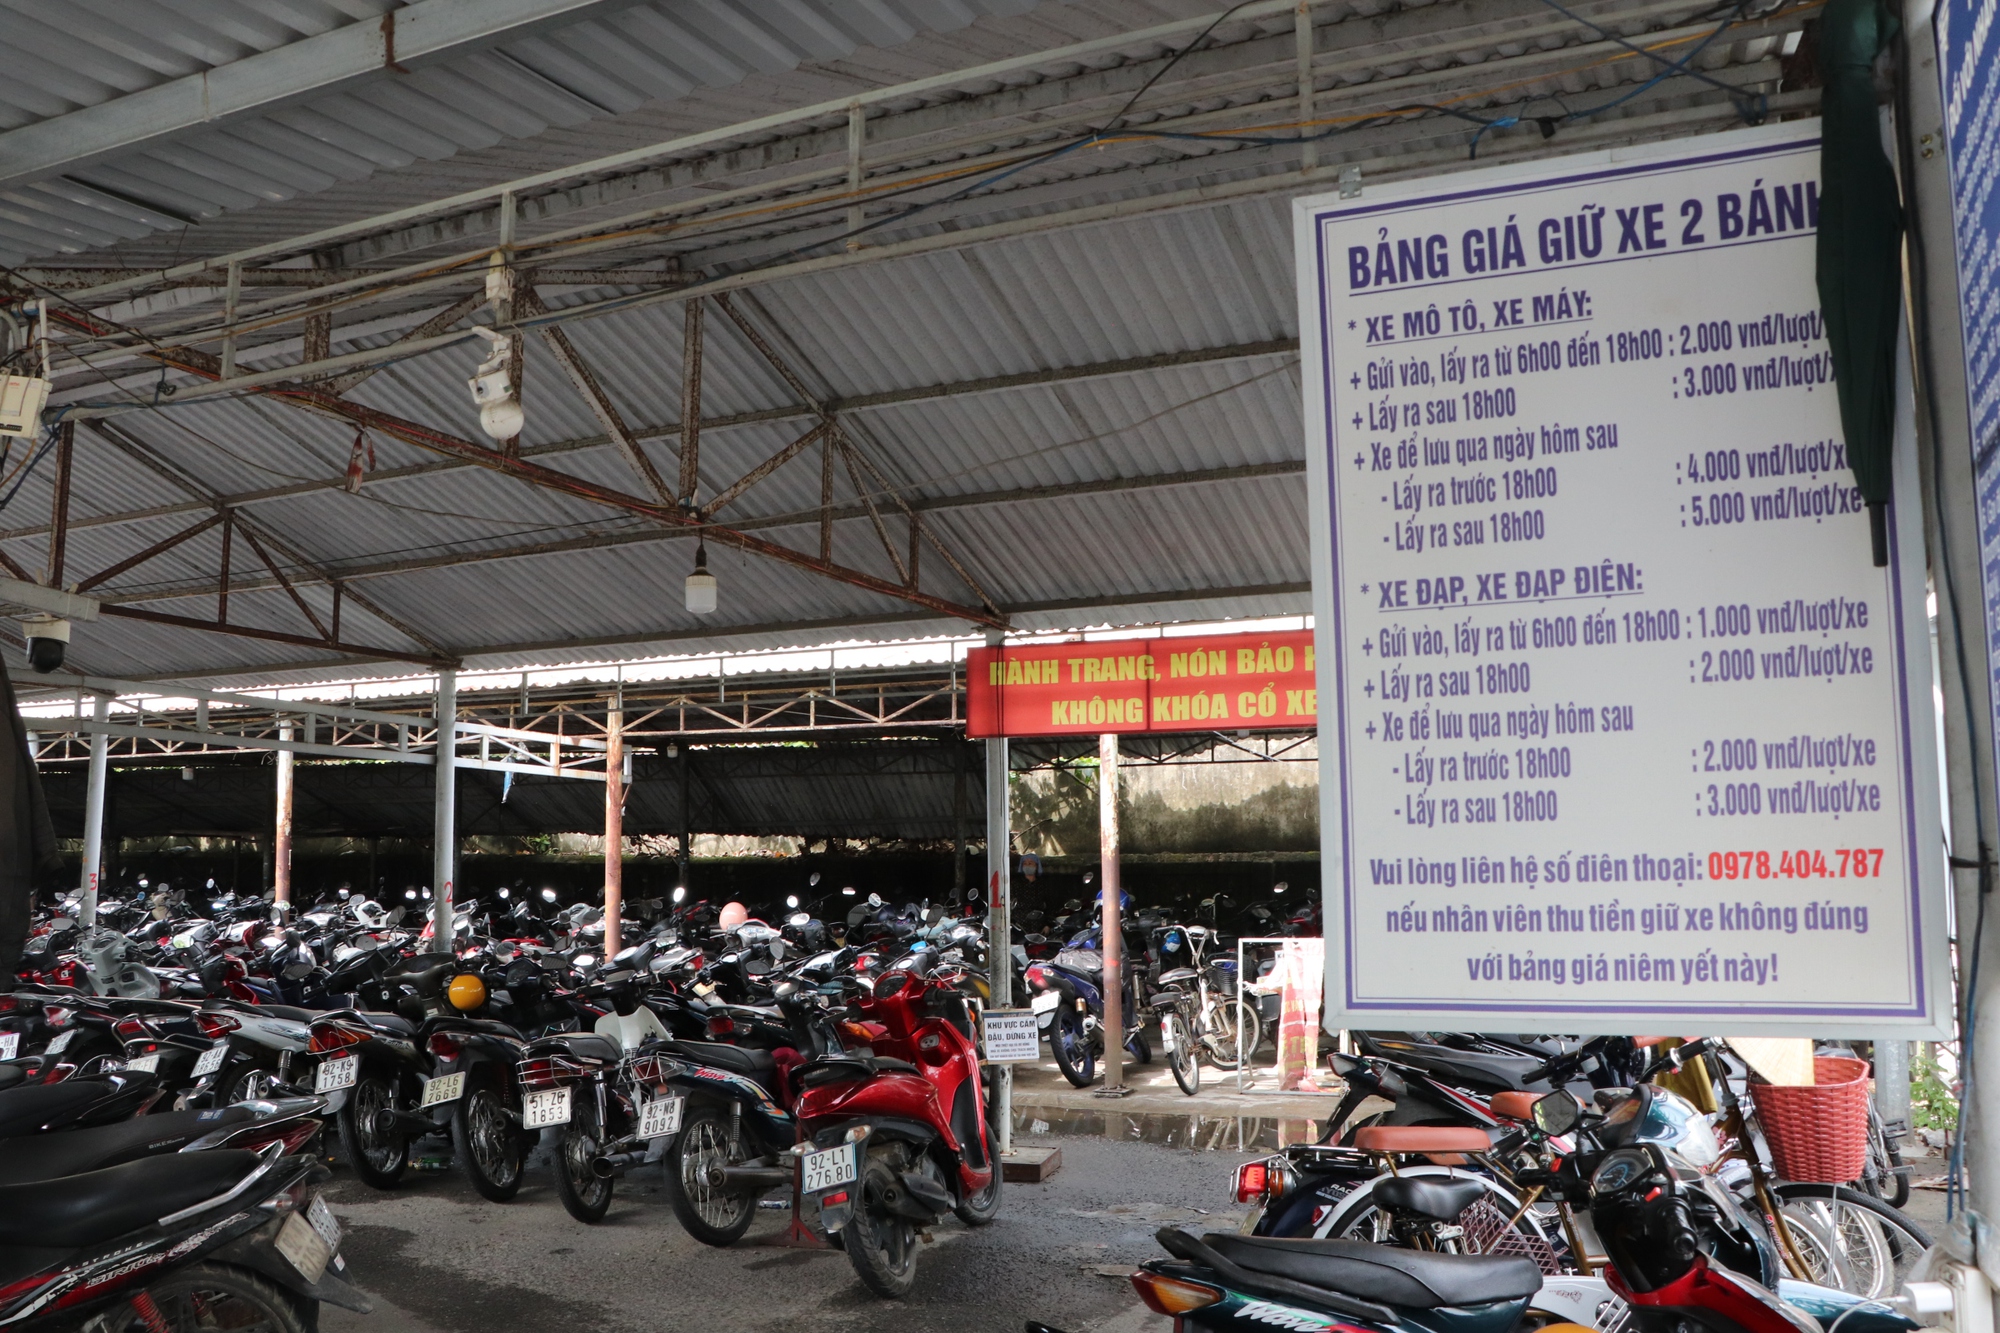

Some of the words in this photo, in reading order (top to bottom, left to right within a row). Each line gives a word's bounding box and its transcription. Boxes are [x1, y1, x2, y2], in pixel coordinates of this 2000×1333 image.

[1349, 227, 1449, 289] BẢNG
[1462, 214, 1525, 273] GIÁ
[1538, 204, 1605, 263] GIỮ
[1615, 203, 1666, 253] XE
[1681, 199, 1704, 245] 2
[1366, 315, 1394, 342] XE
[1403, 304, 1440, 337] MÔ
[1448, 299, 1484, 331] TÔ,
[1493, 299, 1523, 326] XE
[1533, 287, 1591, 322] MÁY:
[1367, 357, 1393, 390] Gửi
[1400, 356, 1434, 386] vào,
[1441, 346, 1465, 383] lấy
[1472, 354, 1489, 378] ra
[1495, 345, 1511, 376] từ
[1517, 341, 1560, 373] 6h00
[1567, 330, 1599, 367] đến
[1606, 329, 1662, 362] 18h00
[1680, 320, 1731, 354] 2.000
[1369, 395, 1397, 432] Lấy
[1404, 403, 1420, 426] ra
[1426, 399, 1456, 424] sau
[1462, 387, 1515, 420] 18h00
[1684, 363, 1736, 397] 3.000
[1371, 442, 1391, 471] Xe
[1398, 431, 1417, 468] để
[1424, 437, 1449, 465] lưu
[1456, 437, 1487, 465] qua
[1494, 427, 1534, 462] ngày
[1541, 423, 1579, 454] hôm
[1586, 424, 1617, 450] sau
[1394, 474, 1421, 512] Lấy
[1428, 483, 1444, 506] ra
[1451, 473, 1496, 505] trước
[1503, 467, 1556, 499] 18h00
[1688, 449, 1739, 482] 4.000
[1746, 437, 1850, 480] vnđ/lượt/x
[1395, 515, 1423, 553] Lấy
[1430, 523, 1447, 547] ra
[1454, 520, 1483, 546] sau
[1490, 510, 1544, 542] 18h00
[1692, 492, 1744, 526] 5.000
[1751, 481, 1862, 524] vnđ/lượt/xe
[1379, 580, 1407, 607] XE
[1416, 576, 1468, 610] ĐẠP,
[1477, 573, 1506, 600] XE
[1516, 569, 1567, 604] ĐẠP
[1575, 559, 1643, 598] ĐIỆN:
[1380, 624, 1406, 657] Gửi
[1413, 625, 1447, 657] vào,
[1455, 616, 1479, 656] lấy
[1487, 627, 1503, 650] ra
[1510, 619, 1526, 649] từ
[1533, 616, 1576, 648] 6h00
[1583, 608, 1616, 644] đến
[1623, 609, 1679, 642] 18h00
[1698, 604, 1750, 637] 1.000
[1757, 597, 1868, 637] vnđ/lượt/xe
[990, 657, 1059, 686] HÀNH
[1067, 654, 1161, 682] TRANG,
[1170, 647, 1226, 678] NÓN
[1237, 642, 1294, 675] BẢO
[1381, 663, 1409, 701] Lấy
[1416, 673, 1432, 697] ra
[1439, 672, 1469, 696] sau
[1476, 662, 1529, 694] 18h00
[1702, 649, 1754, 682] 2.000
[1761, 642, 1872, 682] vnđ/lượt/xe
[1052, 695, 1144, 726] KHÔNG
[1153, 690, 1229, 722] KHÓA
[1238, 682, 1277, 719] CỔ
[1286, 689, 1317, 716] XE
[1383, 712, 1402, 741] Xe
[1410, 703, 1429, 740] để
[1436, 710, 1462, 738] lưu
[1469, 713, 1500, 741] qua
[1507, 704, 1548, 739] ngày
[1556, 702, 1594, 733] hôm
[1601, 706, 1633, 731] sau
[1405, 746, 1433, 785] Lấy
[1440, 757, 1457, 781] ra
[1463, 749, 1508, 780] trước
[1516, 747, 1570, 778] 18h00
[1704, 738, 1756, 771] 2.000
[1764, 734, 1875, 774] vnđ/lượt/xe
[1407, 788, 1435, 827] Lấy
[1442, 799, 1458, 823] ra
[1465, 798, 1495, 822] sau
[1503, 790, 1557, 821] 18h00
[1708, 783, 1760, 815] 3.000
[1768, 779, 1880, 819] vnđ/lượt/xe
[89, 873, 98, 891] 3
[1370, 859, 1401, 884] Vui
[1408, 858, 1455, 887] lòng
[1462, 856, 1504, 883] liên
[1511, 855, 1537, 888] hệ
[1544, 851, 1571, 882] số
[1633, 853, 1702, 886] thoại:
[1708, 849, 1883, 879] 0978.404.787
[1387, 901, 1426, 931] nếu
[1433, 905, 1487, 931] nhân
[1493, 904, 1541, 931] viên
[1547, 905, 1583, 931] thu
[1589, 899, 1634, 931] tiền
[1641, 903, 1679, 934] giữ
[1685, 908, 1713, 930] xe
[1720, 902, 1797, 933] không
[1804, 901, 1867, 933] đúng
[1467, 953, 1502, 980] với
[1509, 950, 1565, 984] bảng
[1572, 953, 1607, 984] giá
[1614, 953, 1674, 981] niêm
[1681, 949, 1718, 984] yết
[1724, 953, 1777, 985] này!
[988, 1021, 1002, 1029] KHU
[1028, 1031, 1037, 1039] XE
[323, 1072, 351, 1089] 1758
[324, 1059, 352, 1076] 92-K9
[430, 1075, 459, 1092] 92-L6
[428, 1086, 457, 1104] 2669
[532, 1107, 563, 1124] 1853
[644, 1115, 673, 1135] 9092
[807, 1164, 853, 1193] 276.80
[810, 1149, 845, 1171] 92-L1
[1234, 1300, 1331, 1332] Wave
